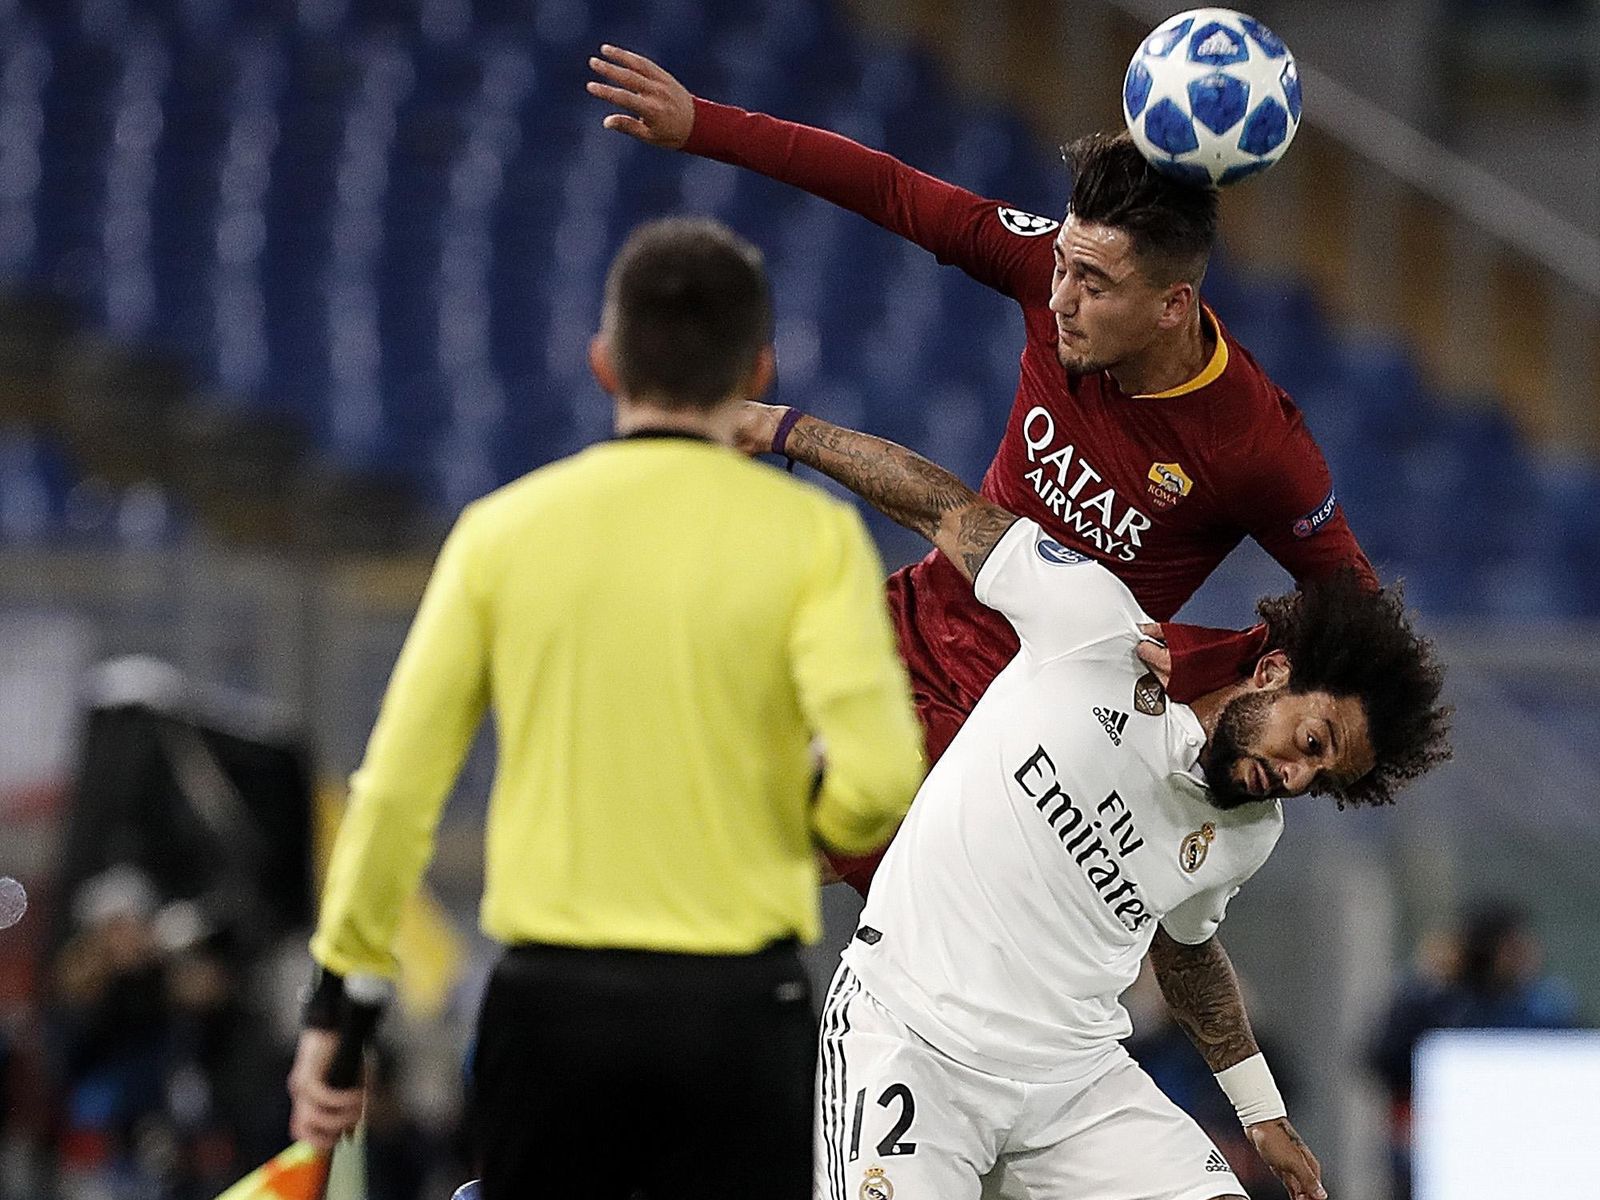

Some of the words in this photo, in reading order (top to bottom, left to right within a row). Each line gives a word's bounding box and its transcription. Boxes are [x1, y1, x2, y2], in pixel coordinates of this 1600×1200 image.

[1023, 406, 1152, 548] QATAR
[1024, 467, 1136, 561] AIRWAYS
[1147, 484, 1177, 505] ROMA
[1092, 706, 1122, 747] adidas
[1014, 743, 1152, 931] Emirates
[1097, 789, 1144, 858] Fly
[849, 1083, 917, 1162] 12
